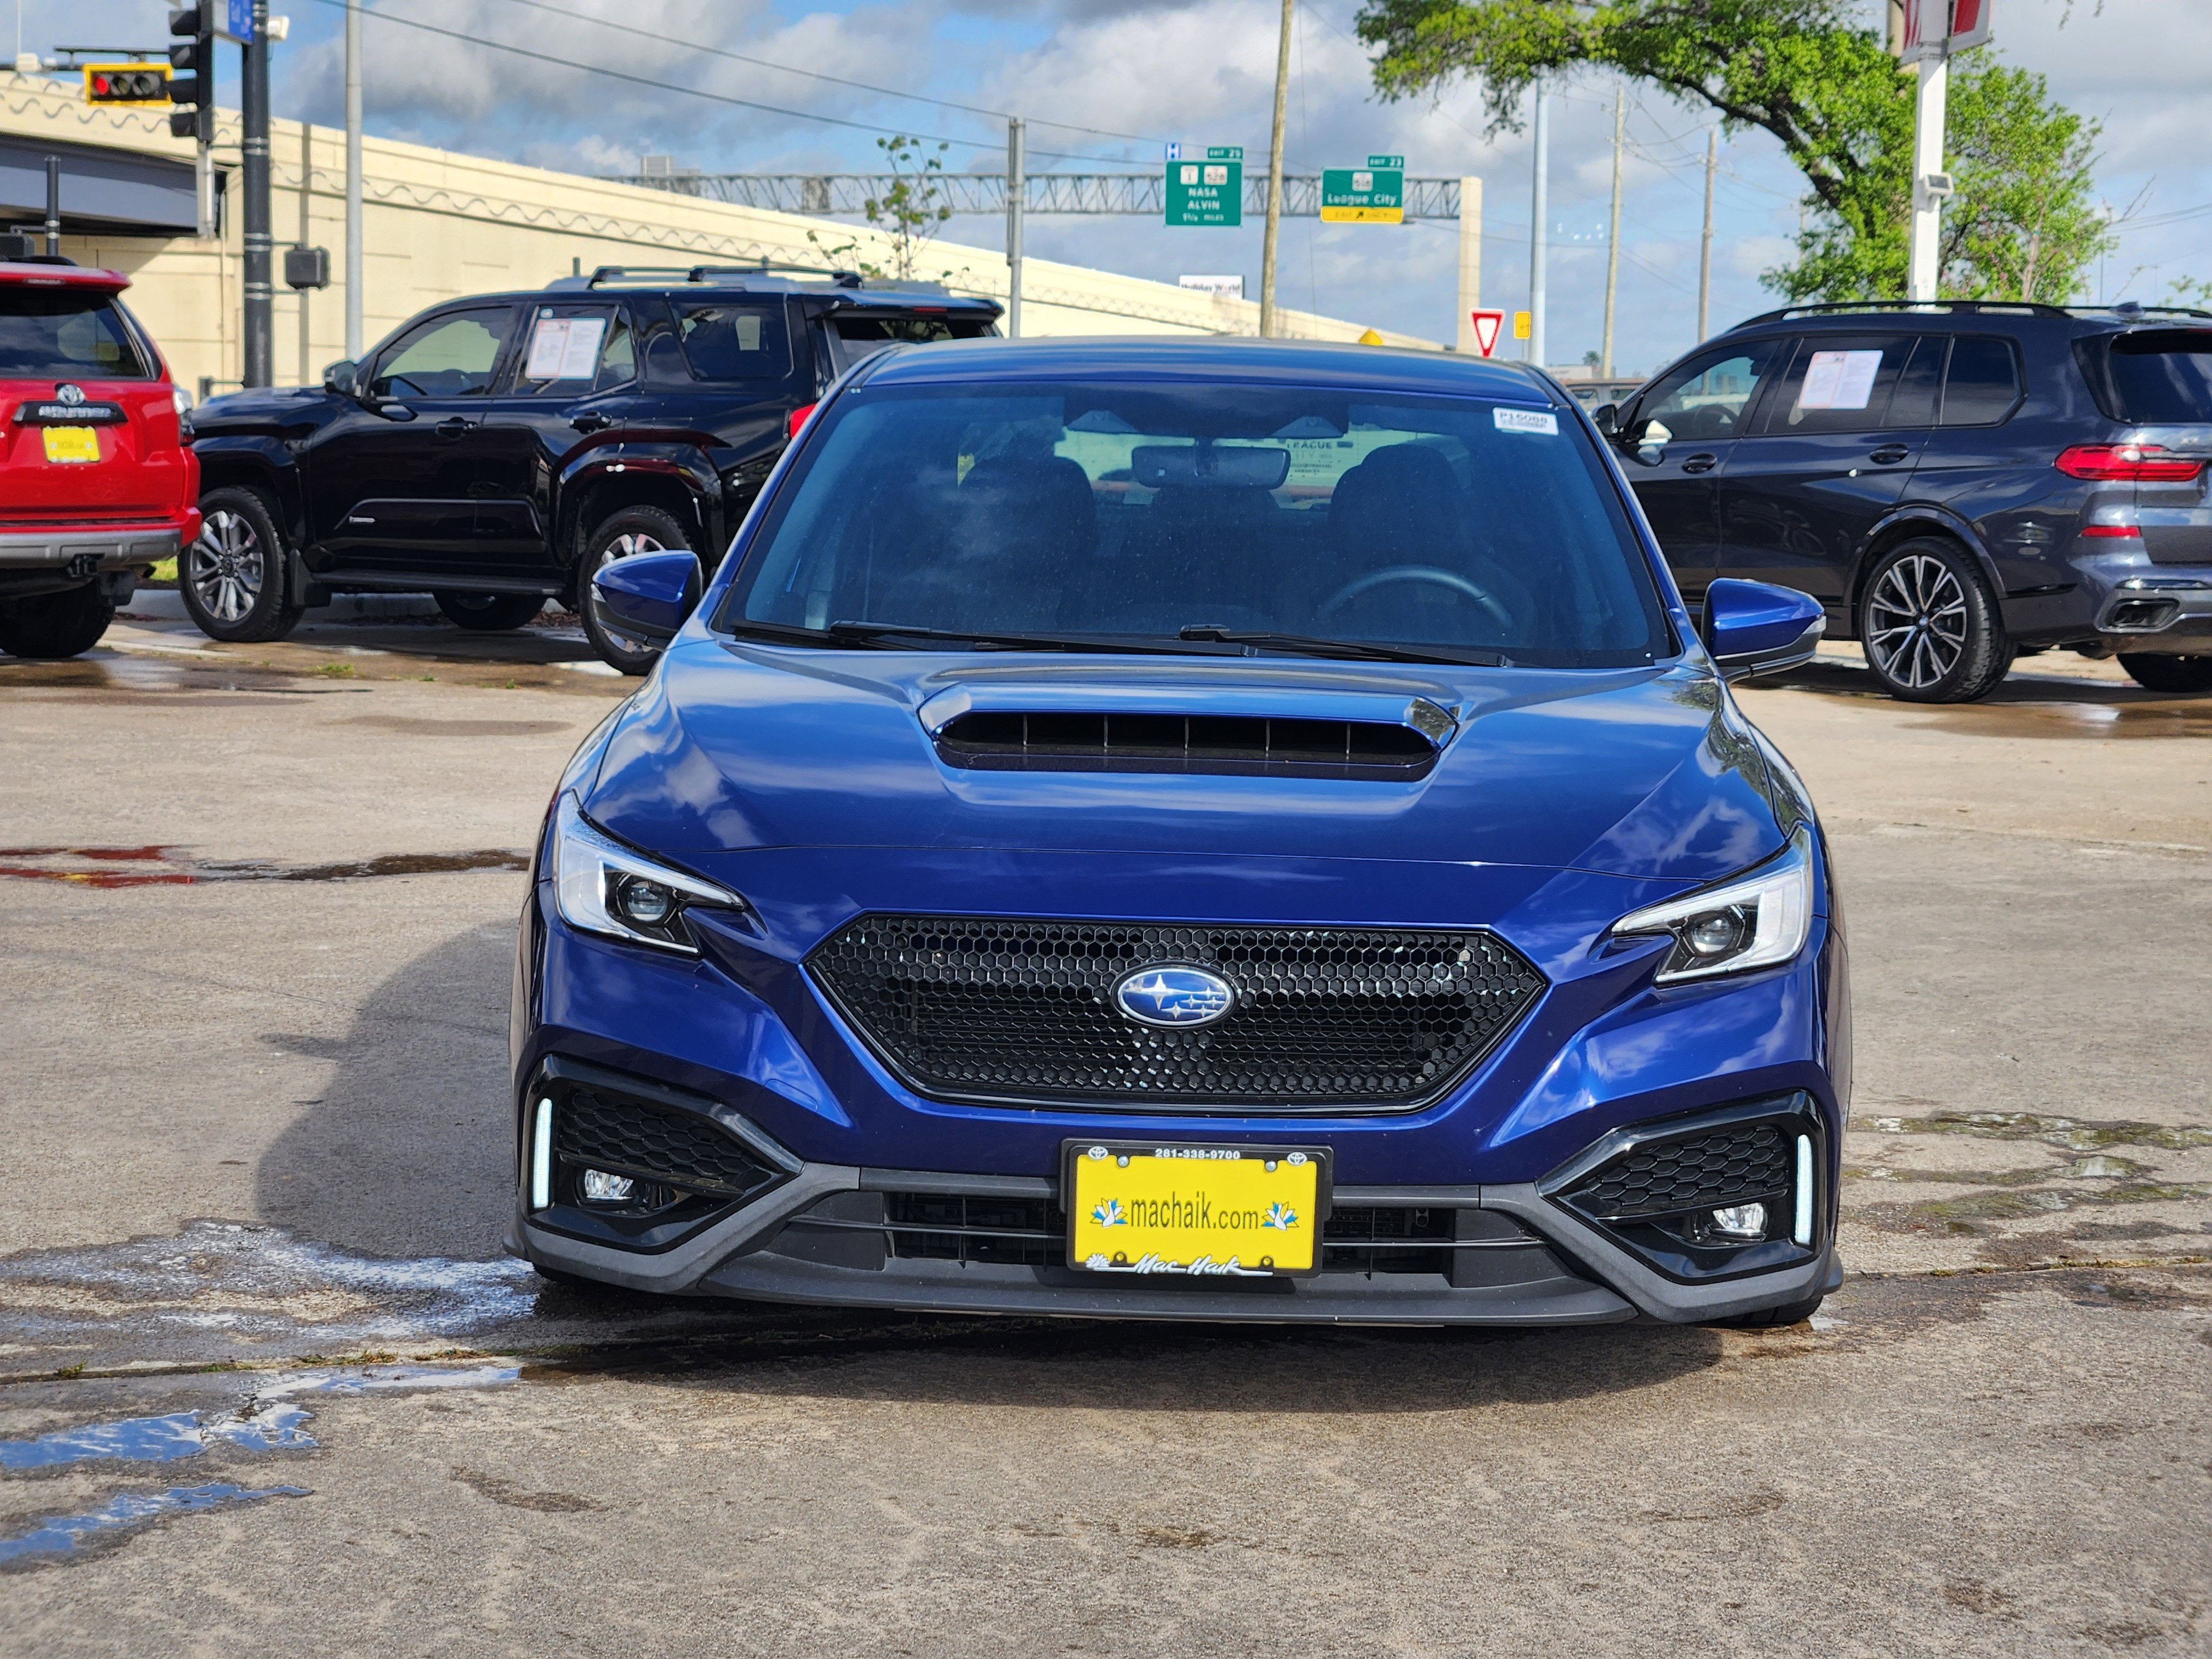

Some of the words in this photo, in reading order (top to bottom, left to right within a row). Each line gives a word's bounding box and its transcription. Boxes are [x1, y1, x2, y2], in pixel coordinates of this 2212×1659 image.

[1188, 187, 1218, 197] NASA
[1187, 200, 1220, 210] ALVIN
[1327, 193, 1369, 206] League
[1374, 193, 1397, 207] City
[1155, 1148, 1240, 1160] 281-338-9700
[1130, 1191, 1259, 1229] machaik.com
[1133, 1253, 1178, 1274] Mac
[1186, 1254, 1241, 1276] Haik
